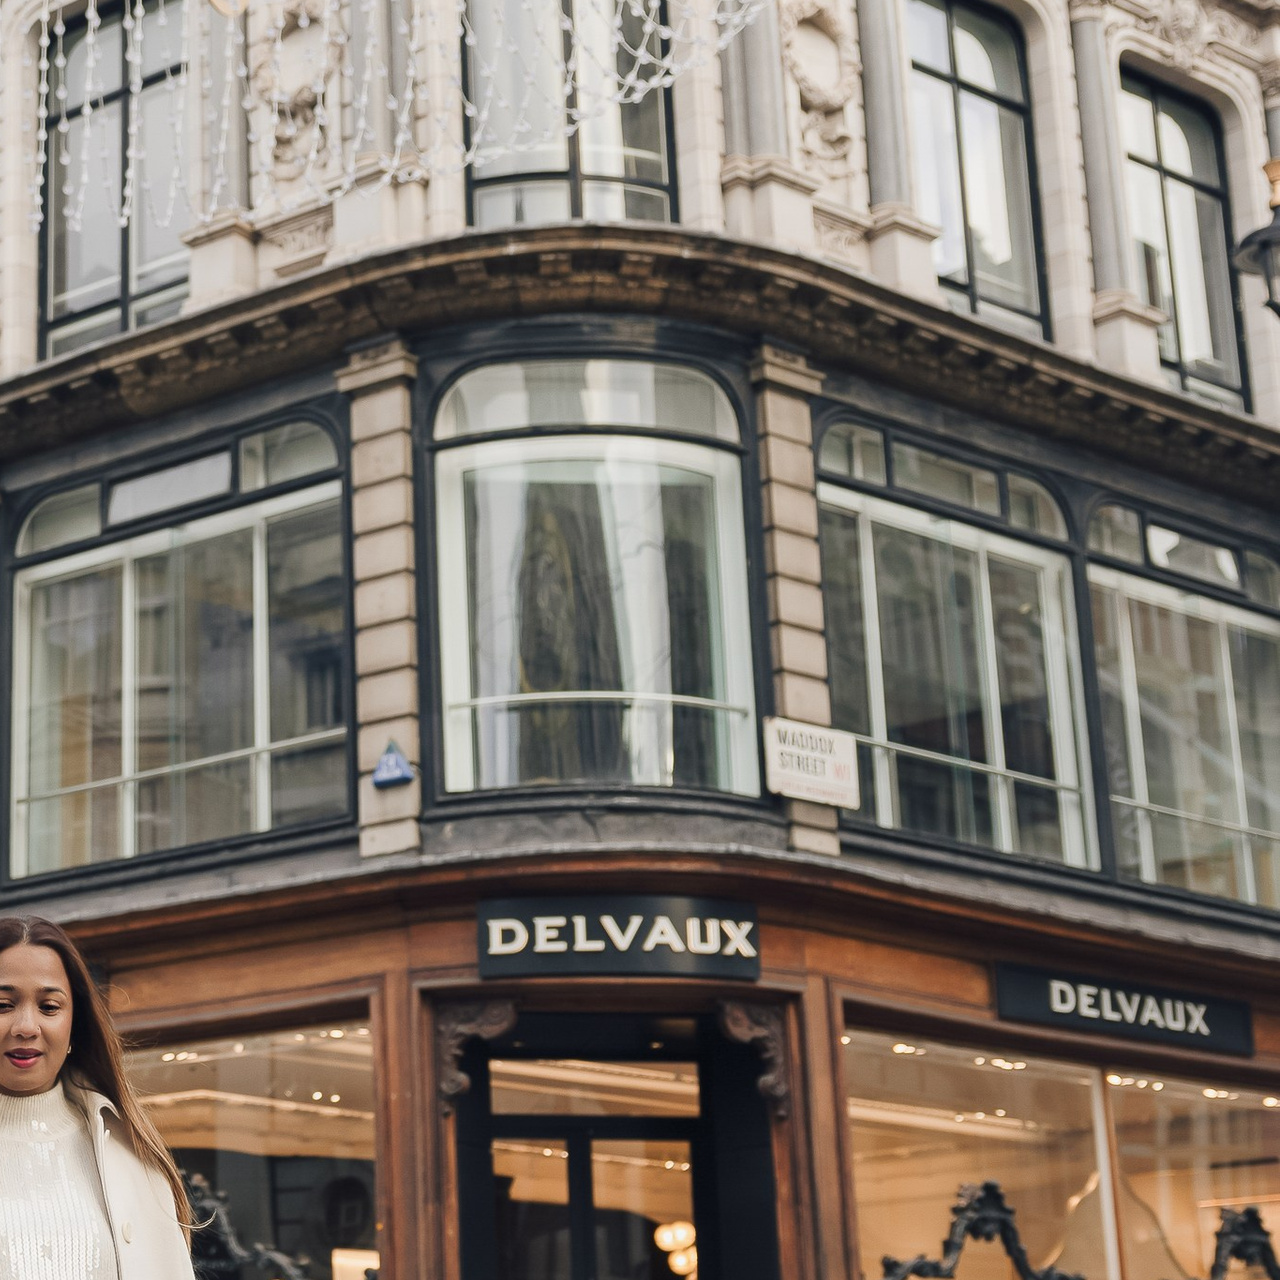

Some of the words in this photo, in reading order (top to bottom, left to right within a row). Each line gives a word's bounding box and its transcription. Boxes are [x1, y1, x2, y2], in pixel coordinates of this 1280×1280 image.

[777, 729, 837, 757] MADDOX
[779, 750, 826, 777] STREET
[486, 914, 758, 958] DELVAUX
[1049, 979, 1212, 1036] DELVAUX
